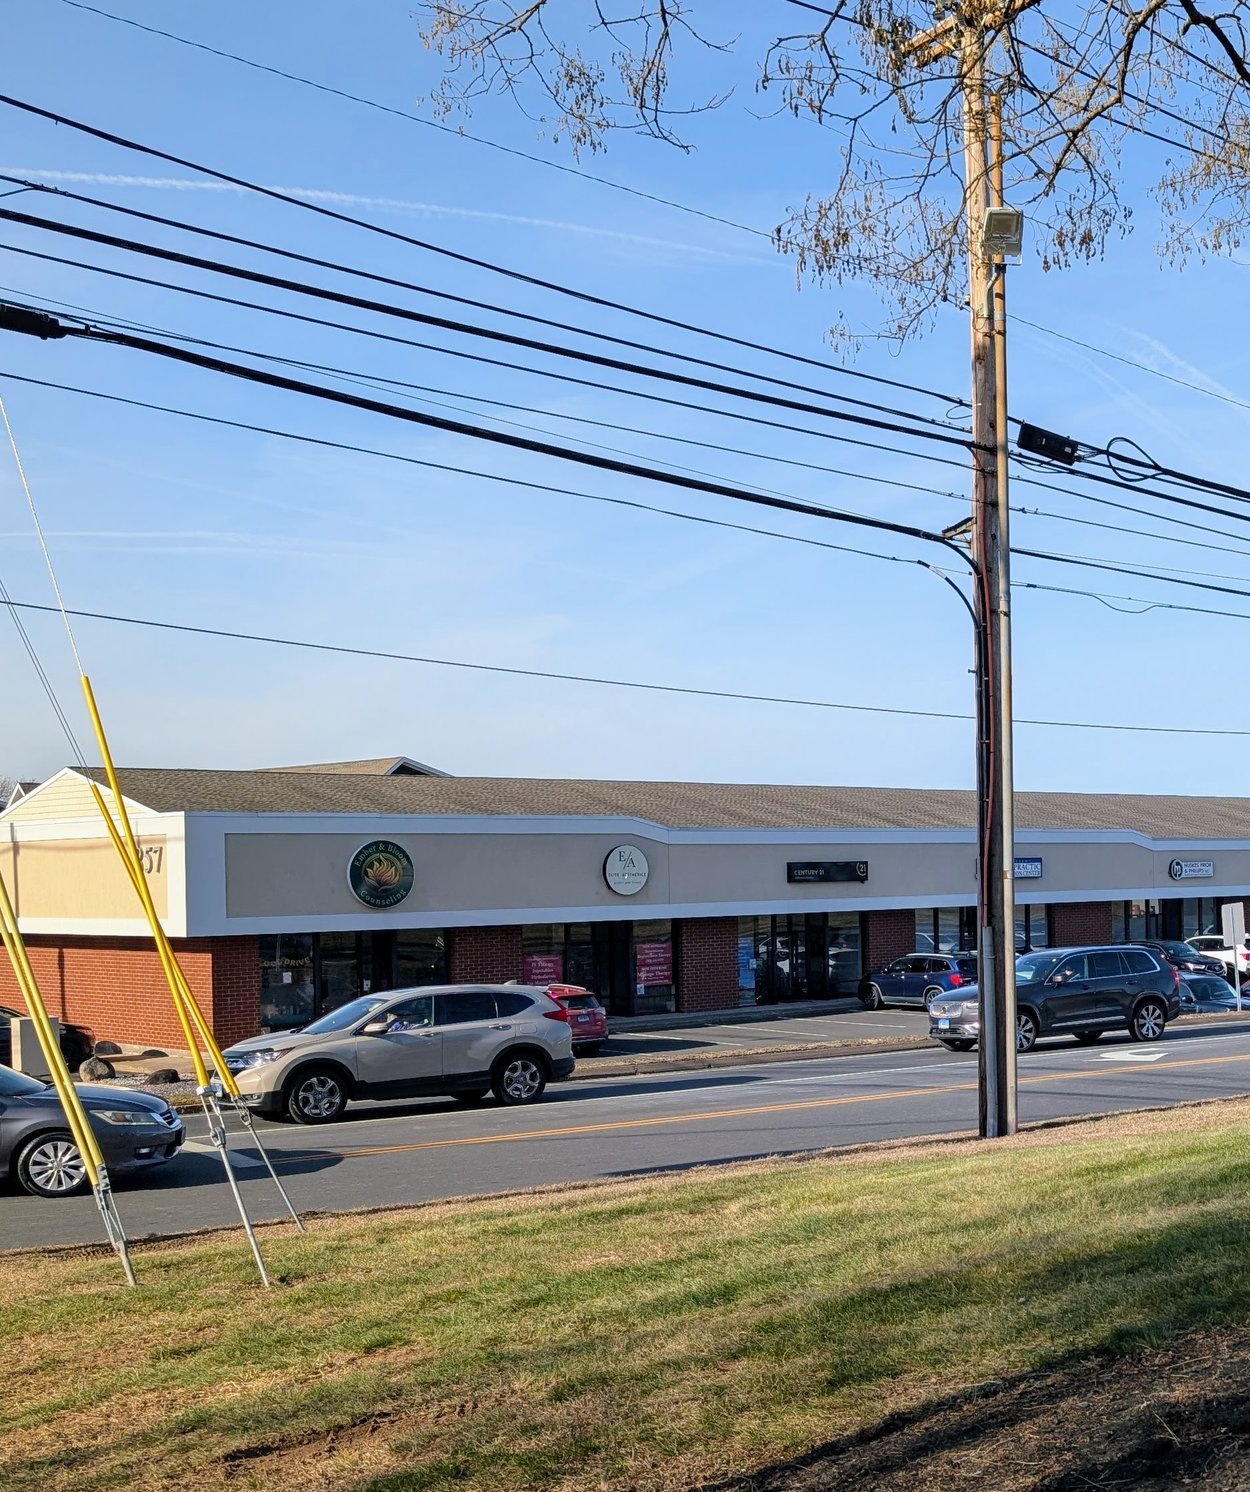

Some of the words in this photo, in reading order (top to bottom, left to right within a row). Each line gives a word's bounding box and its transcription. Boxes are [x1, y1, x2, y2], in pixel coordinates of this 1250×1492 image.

[354, 845, 377, 867] Ember
[378, 842, 386, 851] &
[388, 844, 408, 866] Bloom
[794, 869, 819, 877] CENTURY
[360, 889, 407, 906] Counseling
[284, 956, 310, 966] DRIVE
